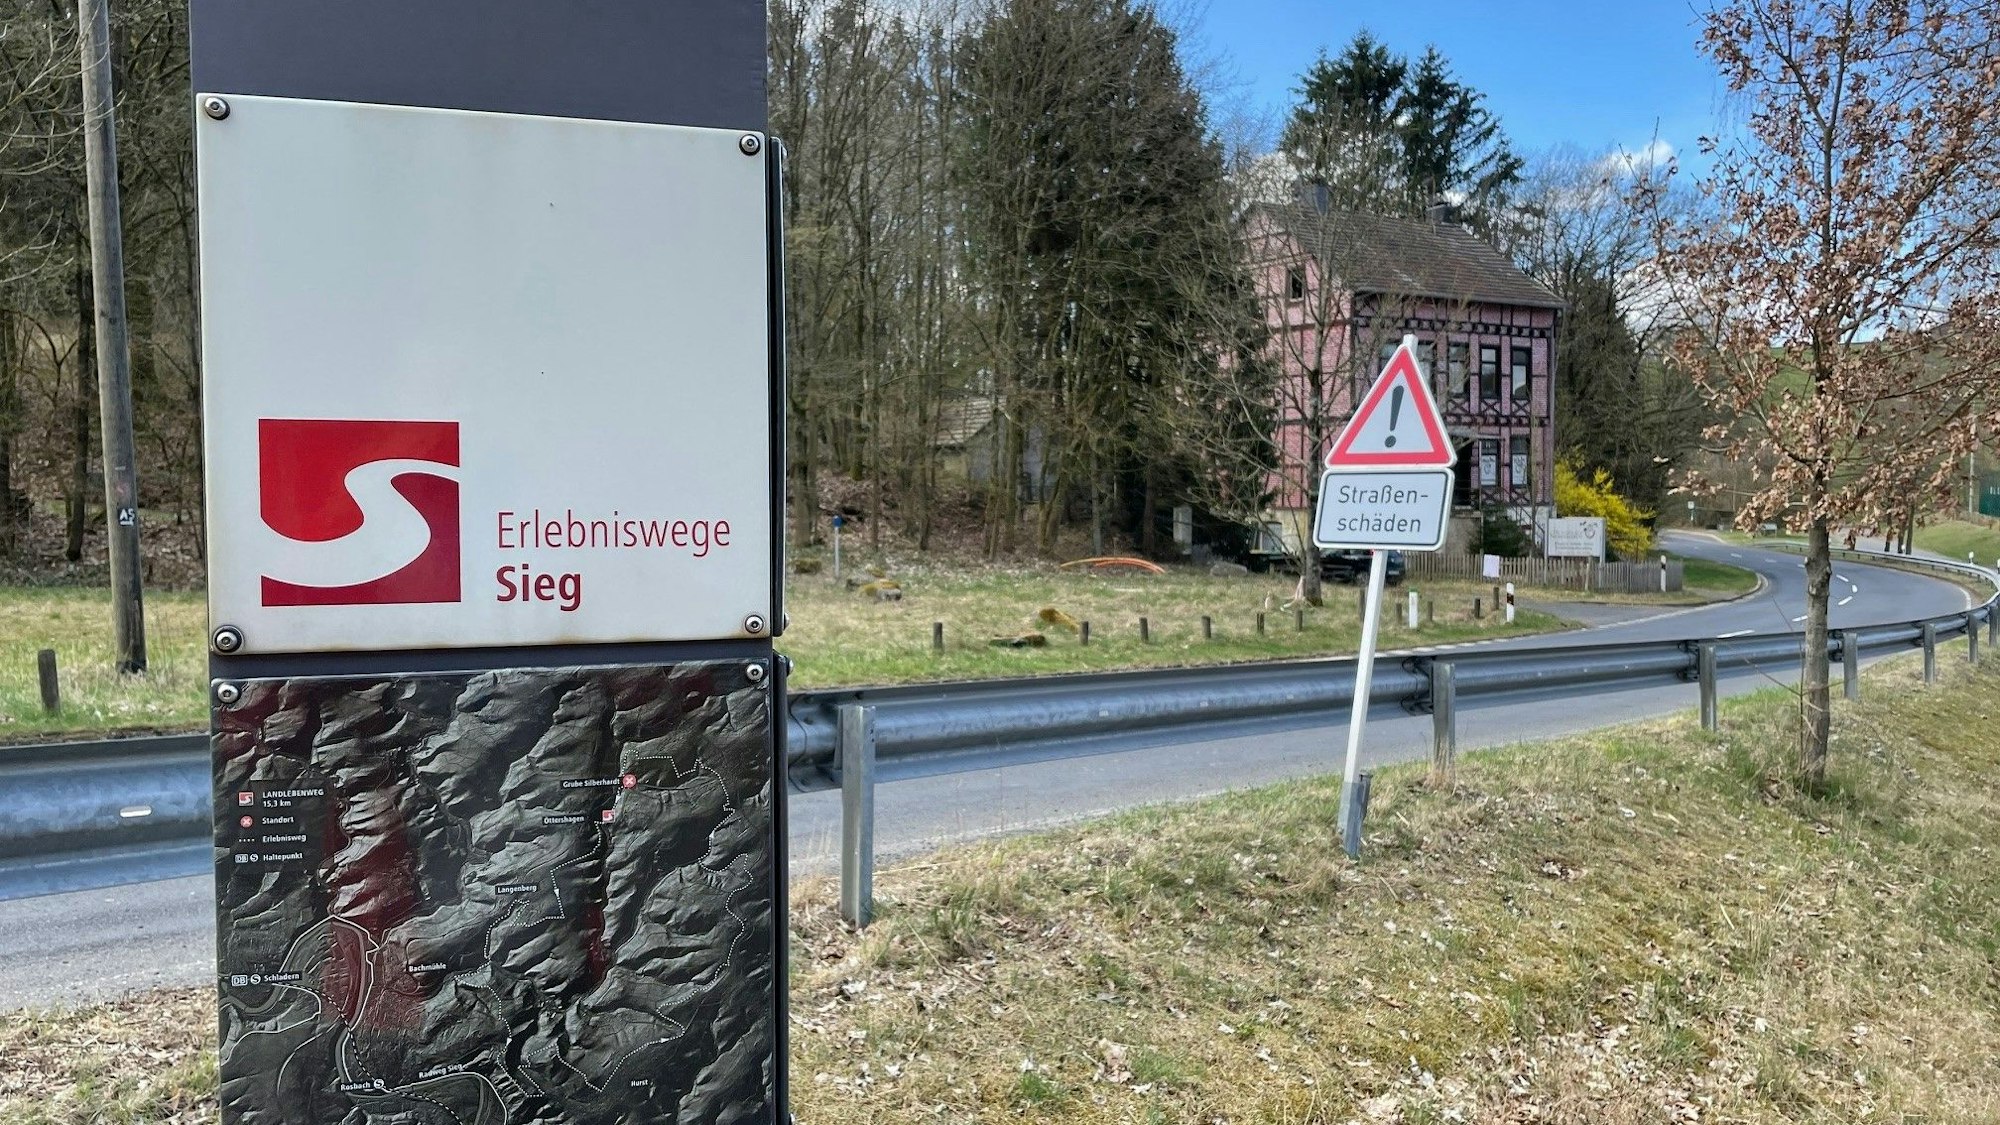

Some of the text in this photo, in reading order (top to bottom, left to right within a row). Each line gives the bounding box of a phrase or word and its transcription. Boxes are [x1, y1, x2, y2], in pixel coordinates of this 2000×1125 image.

[1337, 484, 1429, 504] Straßen-
[1336, 513, 1422, 532] schäden
[497, 508, 731, 558] Erlebniswege
[495, 563, 582, 612] Sieg
[584, 778, 620, 787] Silberhardt
[262, 788, 324, 799] LANDLEBENWEG
[263, 799, 292, 808] 15,3 km
[262, 816, 294, 825] Standort
[543, 815, 585, 825] Ottershagen
[262, 834, 307, 843] Erlebnisweg
[263, 852, 303, 861] Haltepunkt
[497, 884, 537, 894] Langenberg
[408, 962, 447, 972] Bachmühle
[233, 972, 300, 985] DB S Schladern
[418, 1064, 464, 1079] Radweg Sieg
[340, 1079, 385, 1091] Rosbach S
[630, 1079, 648, 1087] Hurst
